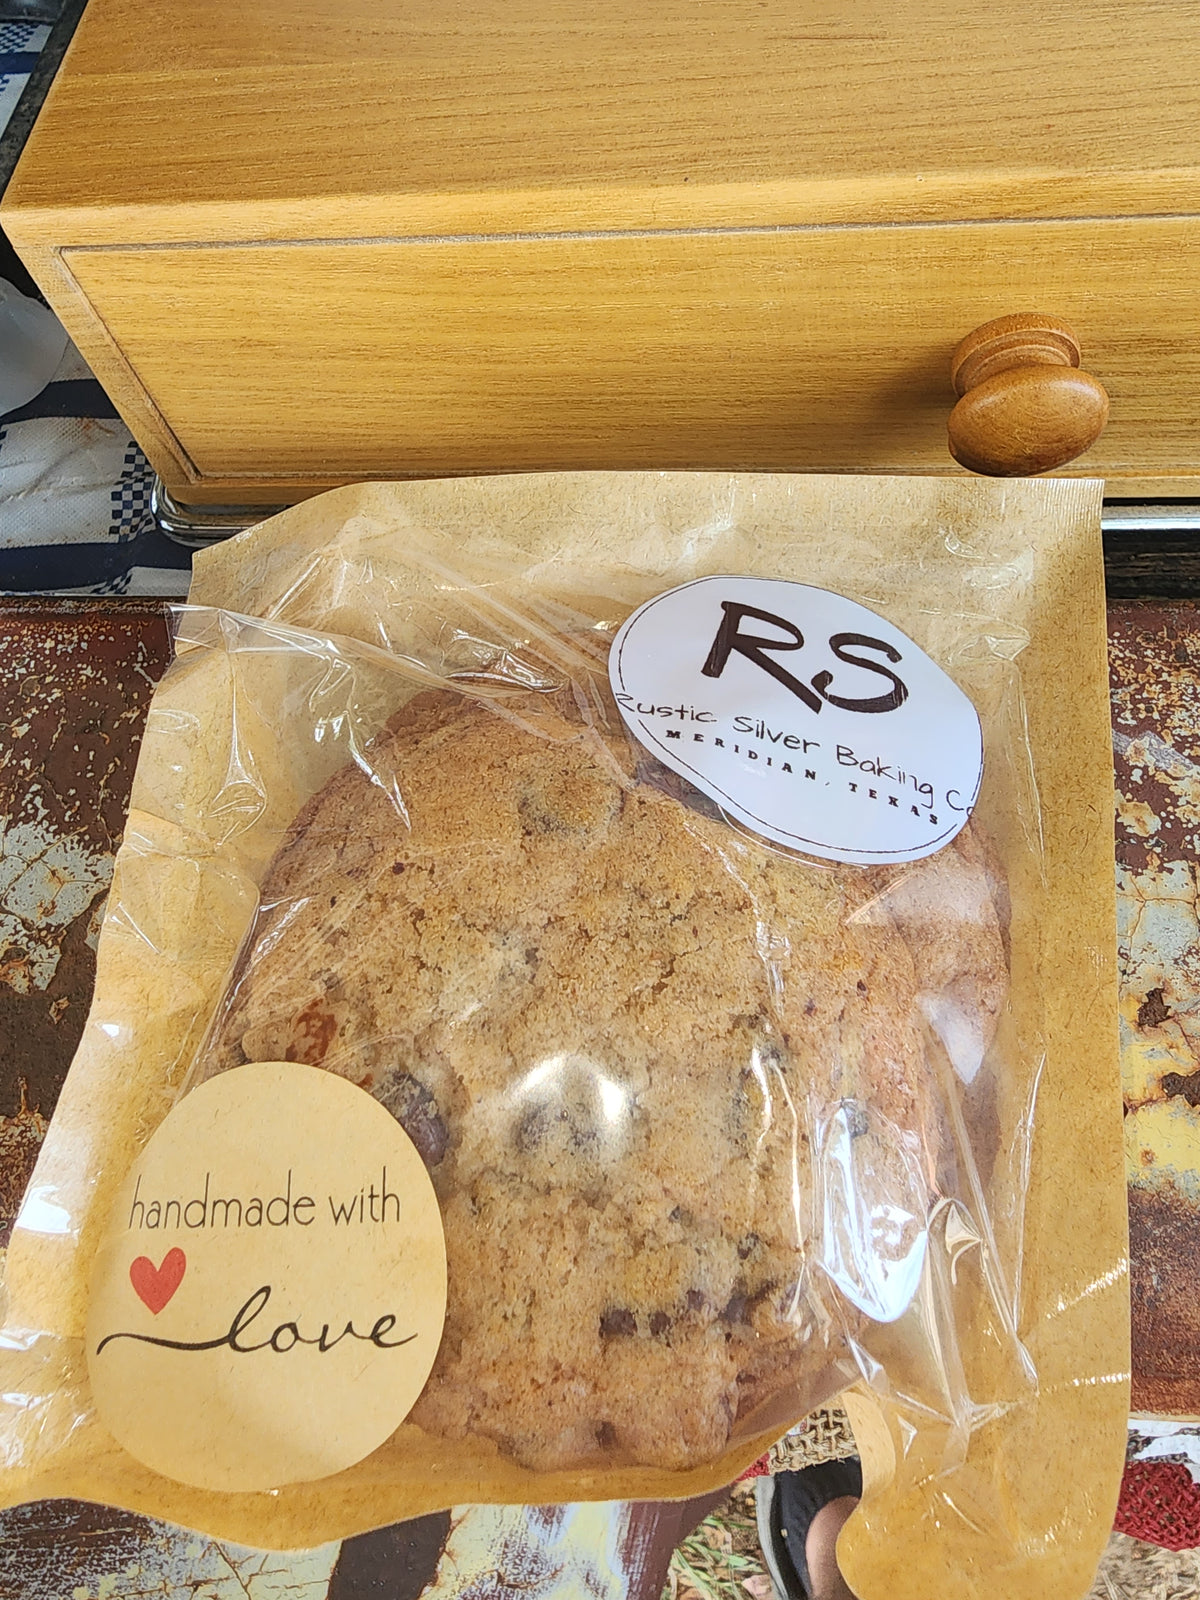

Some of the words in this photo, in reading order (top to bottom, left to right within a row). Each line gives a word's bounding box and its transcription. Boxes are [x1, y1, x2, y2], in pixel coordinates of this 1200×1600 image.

[701, 600, 909, 714] RS
[732, 715, 821, 754] Silver
[836, 743, 934, 808] Baking
[848, 782, 938, 825] TEXAS
[129, 1169, 315, 1229] handmade
[329, 1166, 401, 1226] with
[96, 1285, 418, 1355] love
